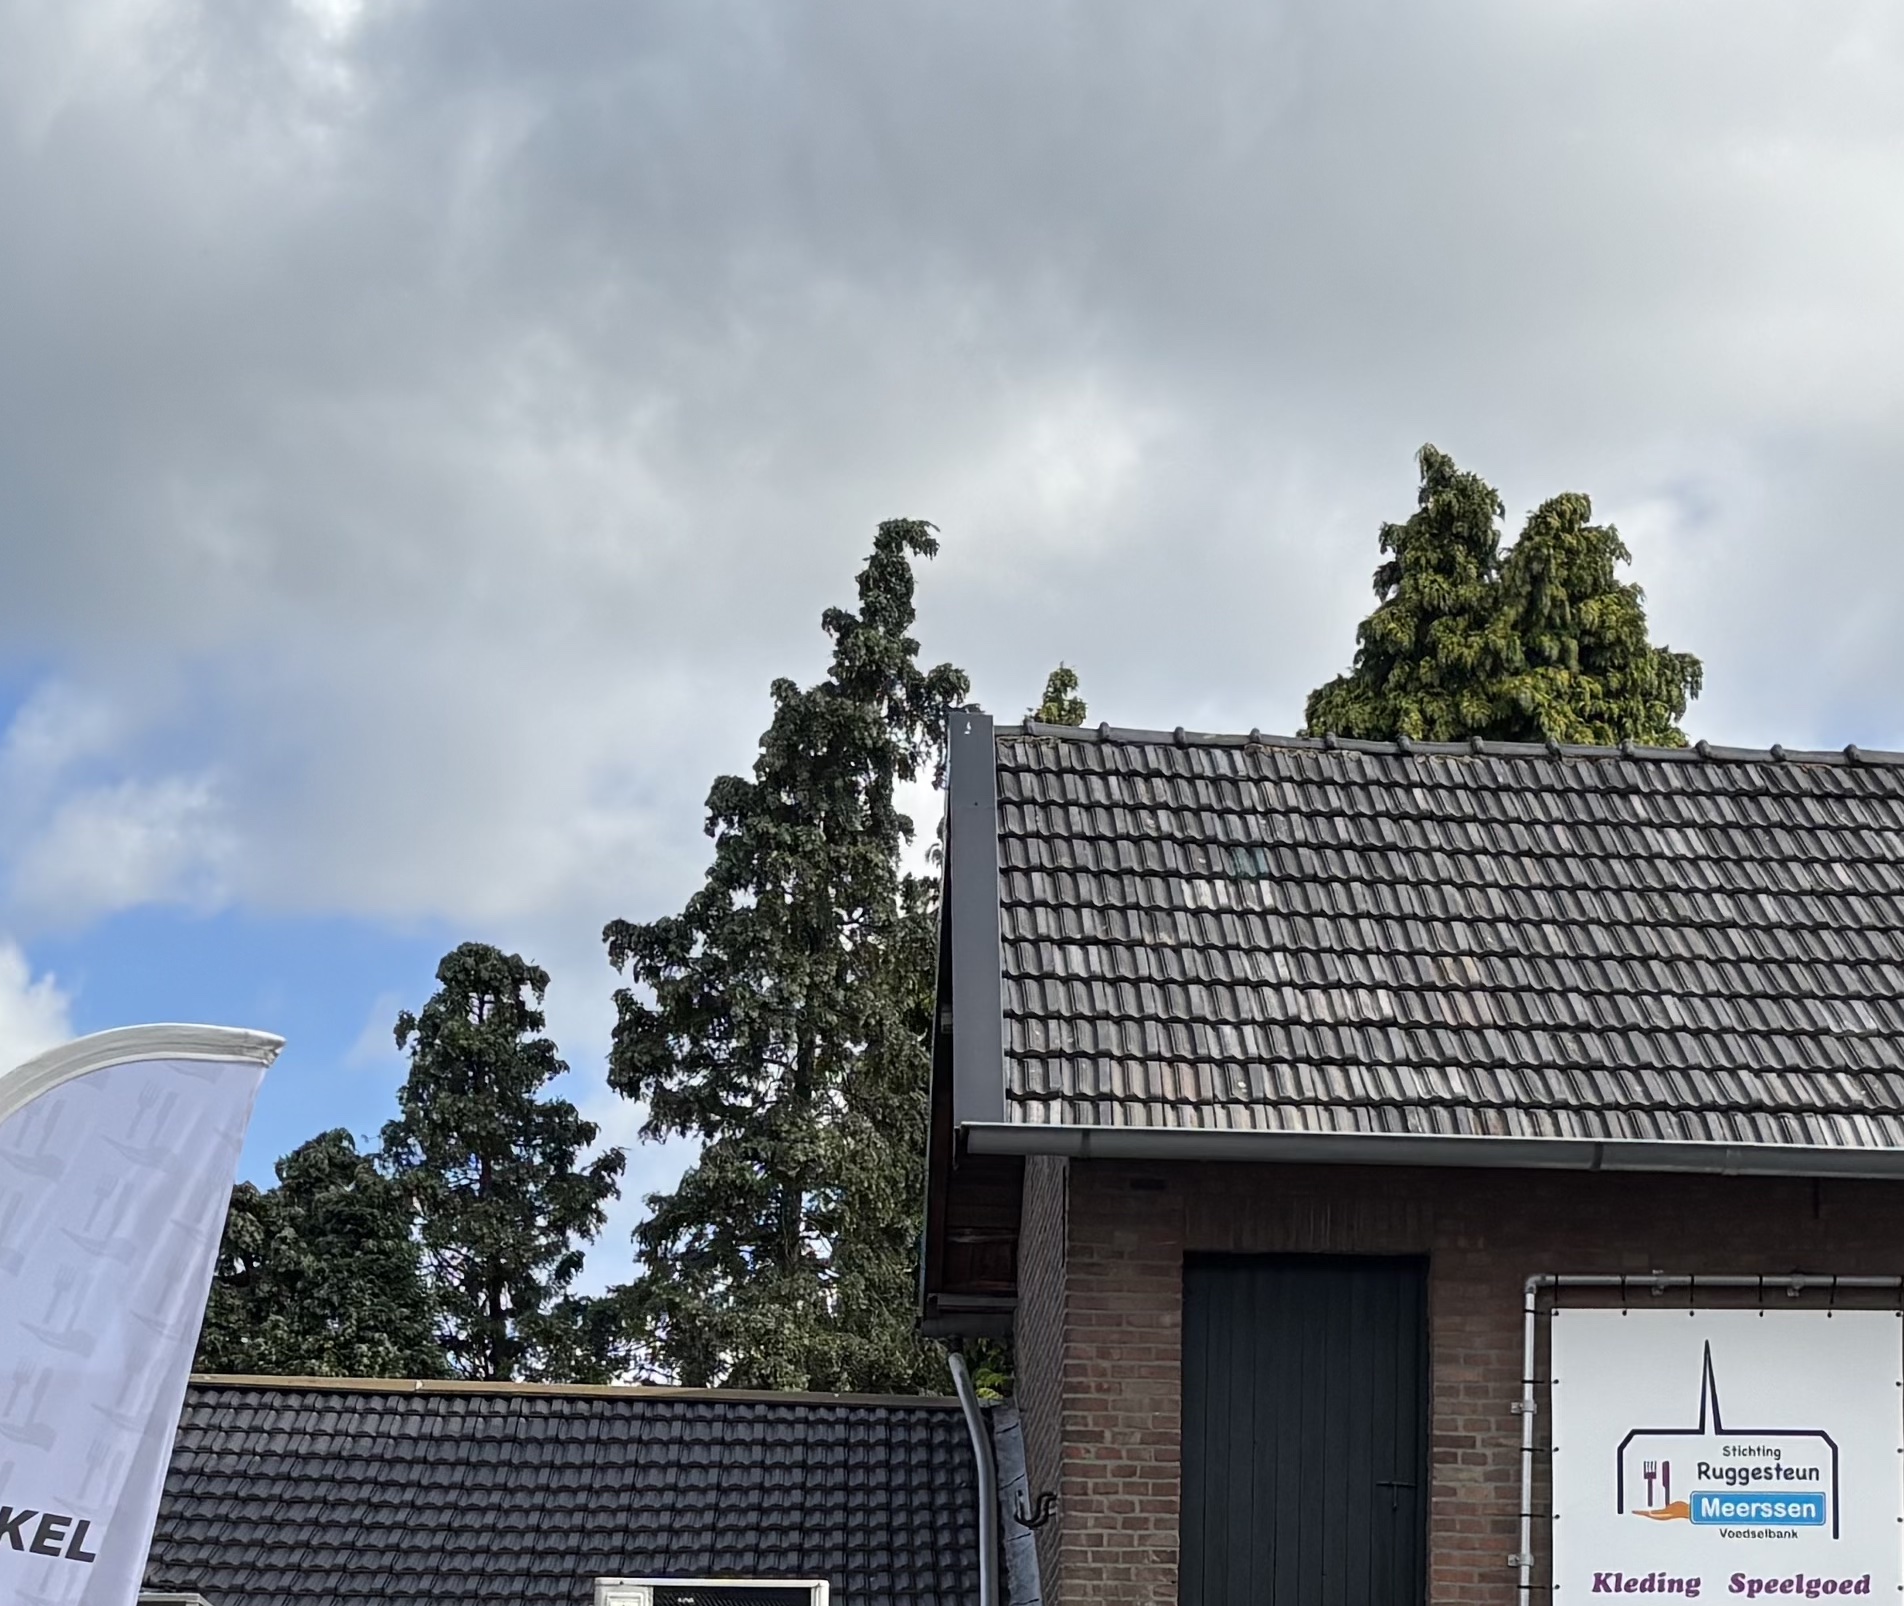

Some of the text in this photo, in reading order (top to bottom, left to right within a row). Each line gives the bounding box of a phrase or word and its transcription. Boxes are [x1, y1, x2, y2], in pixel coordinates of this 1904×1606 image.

[1722, 1445, 1782, 1461] Stichting
[1697, 1461, 1820, 1486] Ruggesteun
[1700, 1497, 1816, 1519] Meerssen
[1719, 1527, 1799, 1540] Voedselbank
[1592, 1572, 1872, 1601] Kleding Speelgoed
